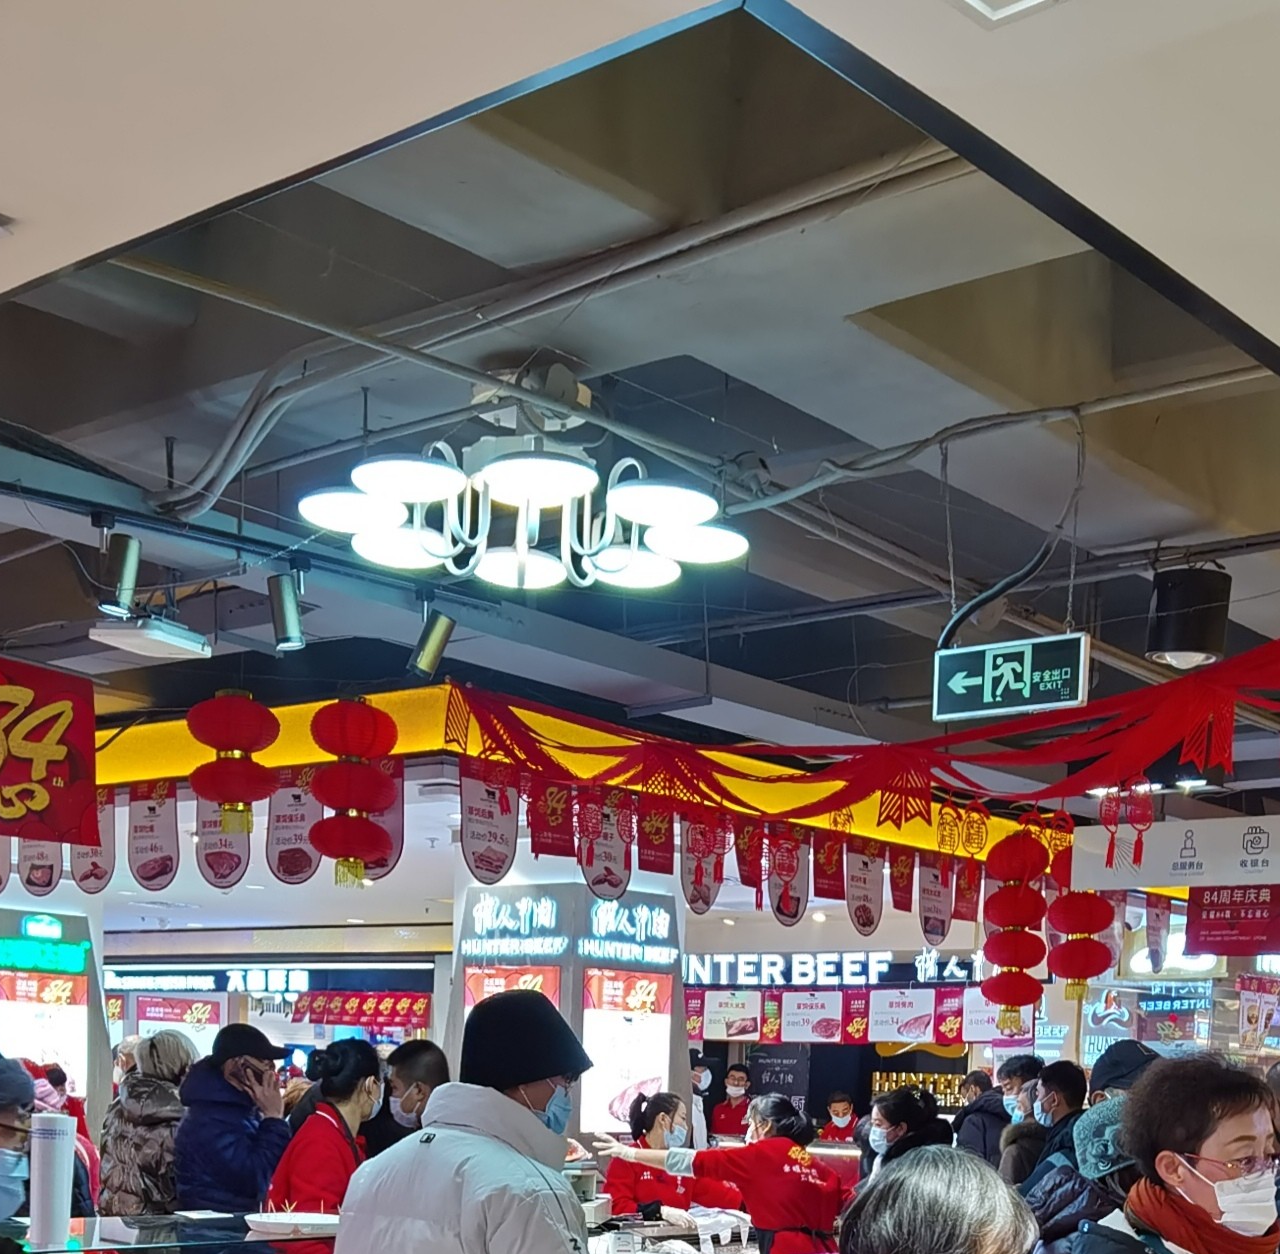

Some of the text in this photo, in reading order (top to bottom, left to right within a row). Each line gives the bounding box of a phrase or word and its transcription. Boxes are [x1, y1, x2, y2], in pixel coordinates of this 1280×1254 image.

[1032, 667, 1071, 683] 安全出口
[1039, 680, 1063, 691] EXIT
[1171, 859, 1204, 872] 总服务台
[1239, 858, 1270, 869] 收银台
[1203, 888, 1271, 905] 84周年庆典
[461, 938, 521, 956] HUNTER
[581, 939, 642, 959] HUNTER
[790, 951, 894, 984] BEEF
